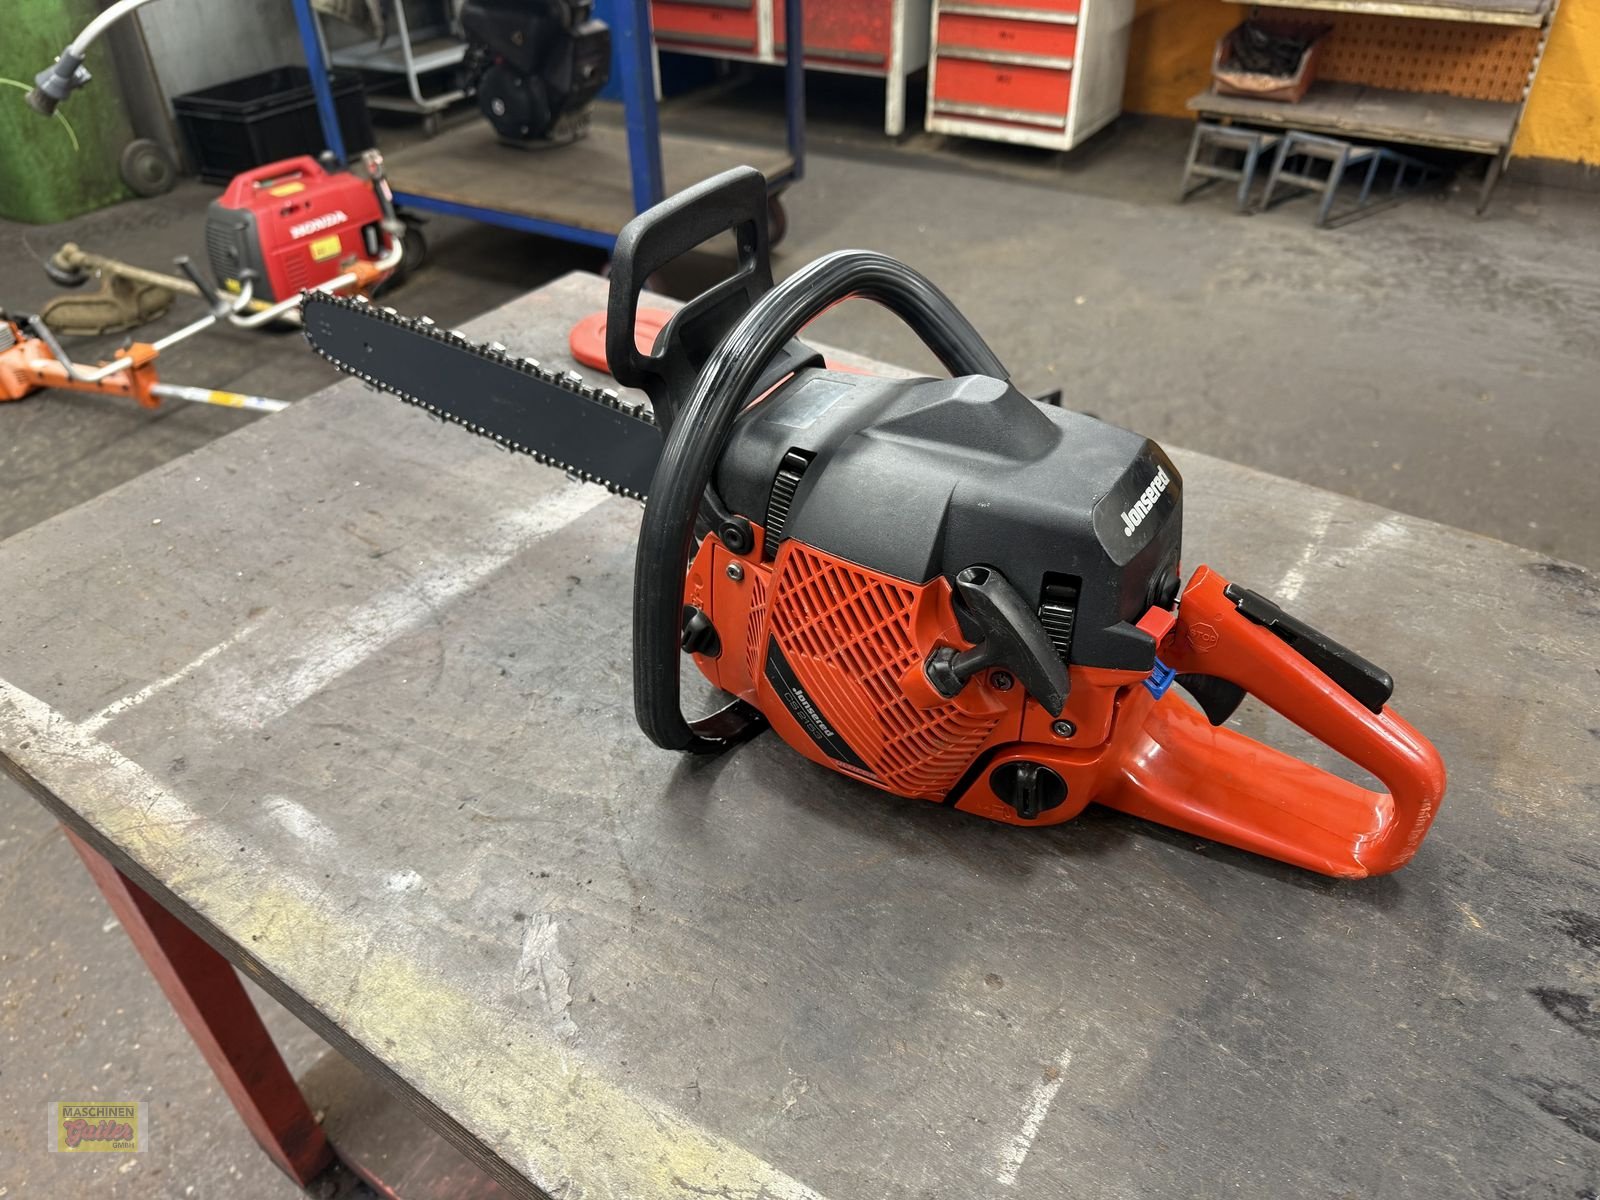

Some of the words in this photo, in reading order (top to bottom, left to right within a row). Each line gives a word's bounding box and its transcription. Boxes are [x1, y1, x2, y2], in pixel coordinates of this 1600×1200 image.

[289, 210, 348, 240] HONDA
[1120, 465, 1170, 537] Jonsered
[792, 687, 835, 737] Jonsered
